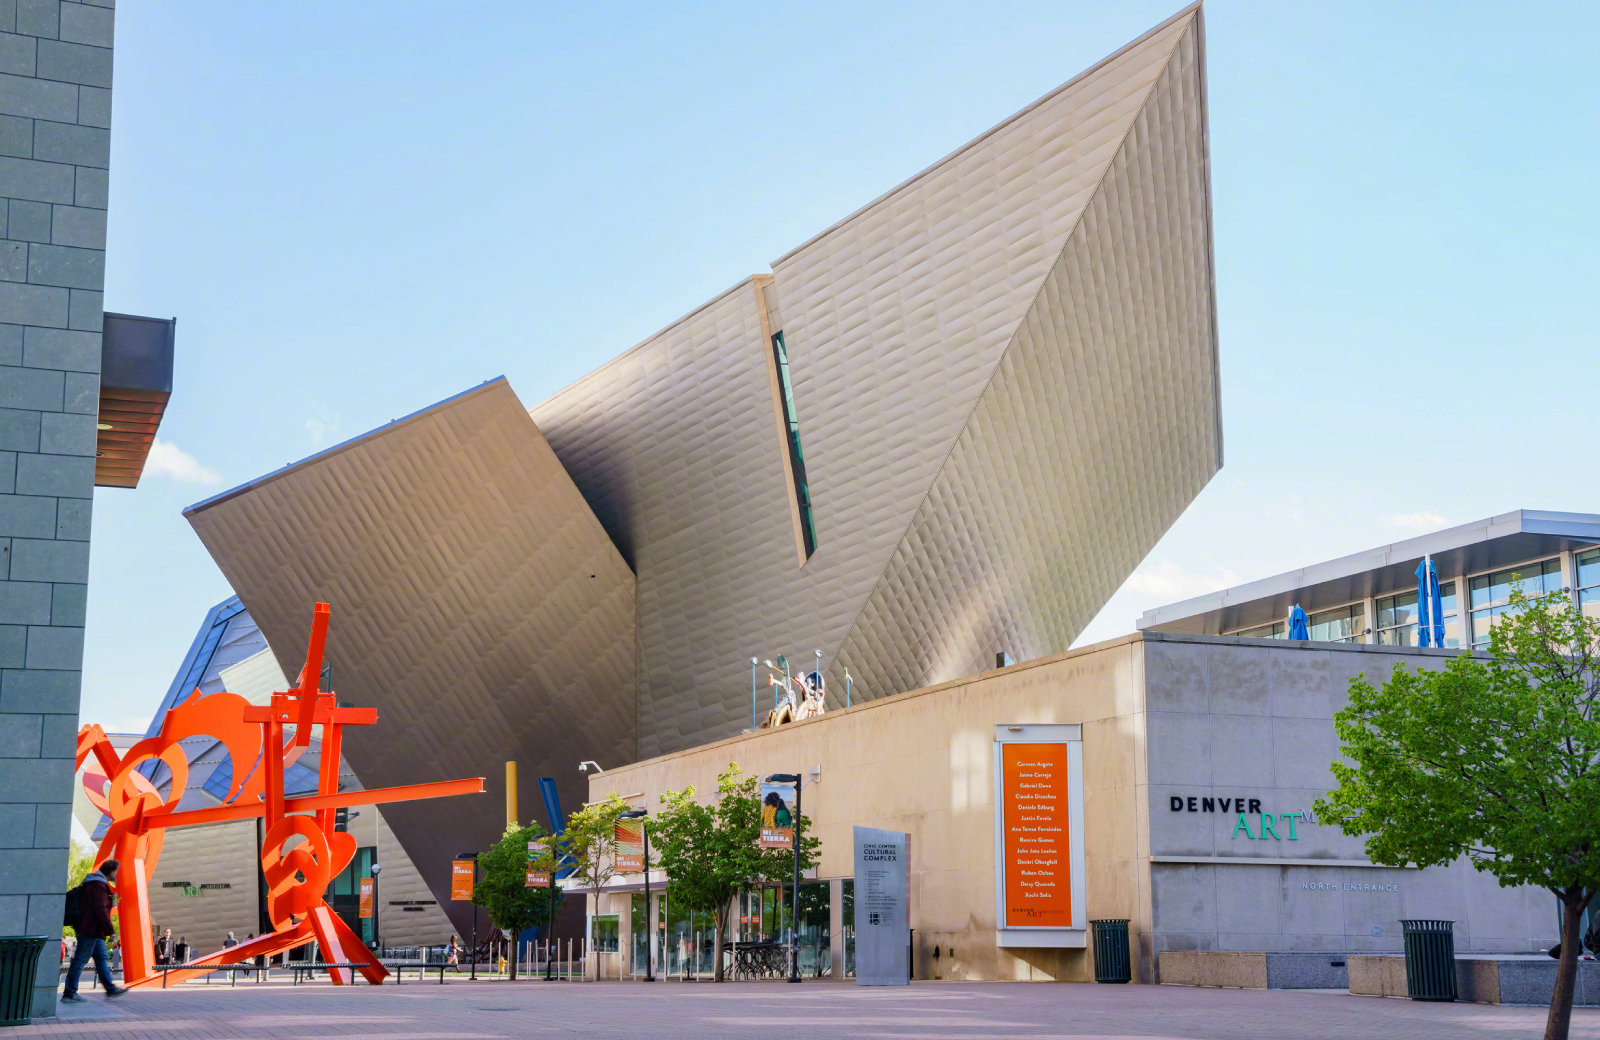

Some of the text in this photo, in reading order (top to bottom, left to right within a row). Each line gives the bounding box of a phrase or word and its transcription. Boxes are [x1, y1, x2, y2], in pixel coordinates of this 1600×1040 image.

[1170, 796, 1262, 814] DENVER
[1231, 812, 1302, 840] ART
[180, 886, 200, 896] ART
[1344, 883, 1399, 892] ENTRANCE
